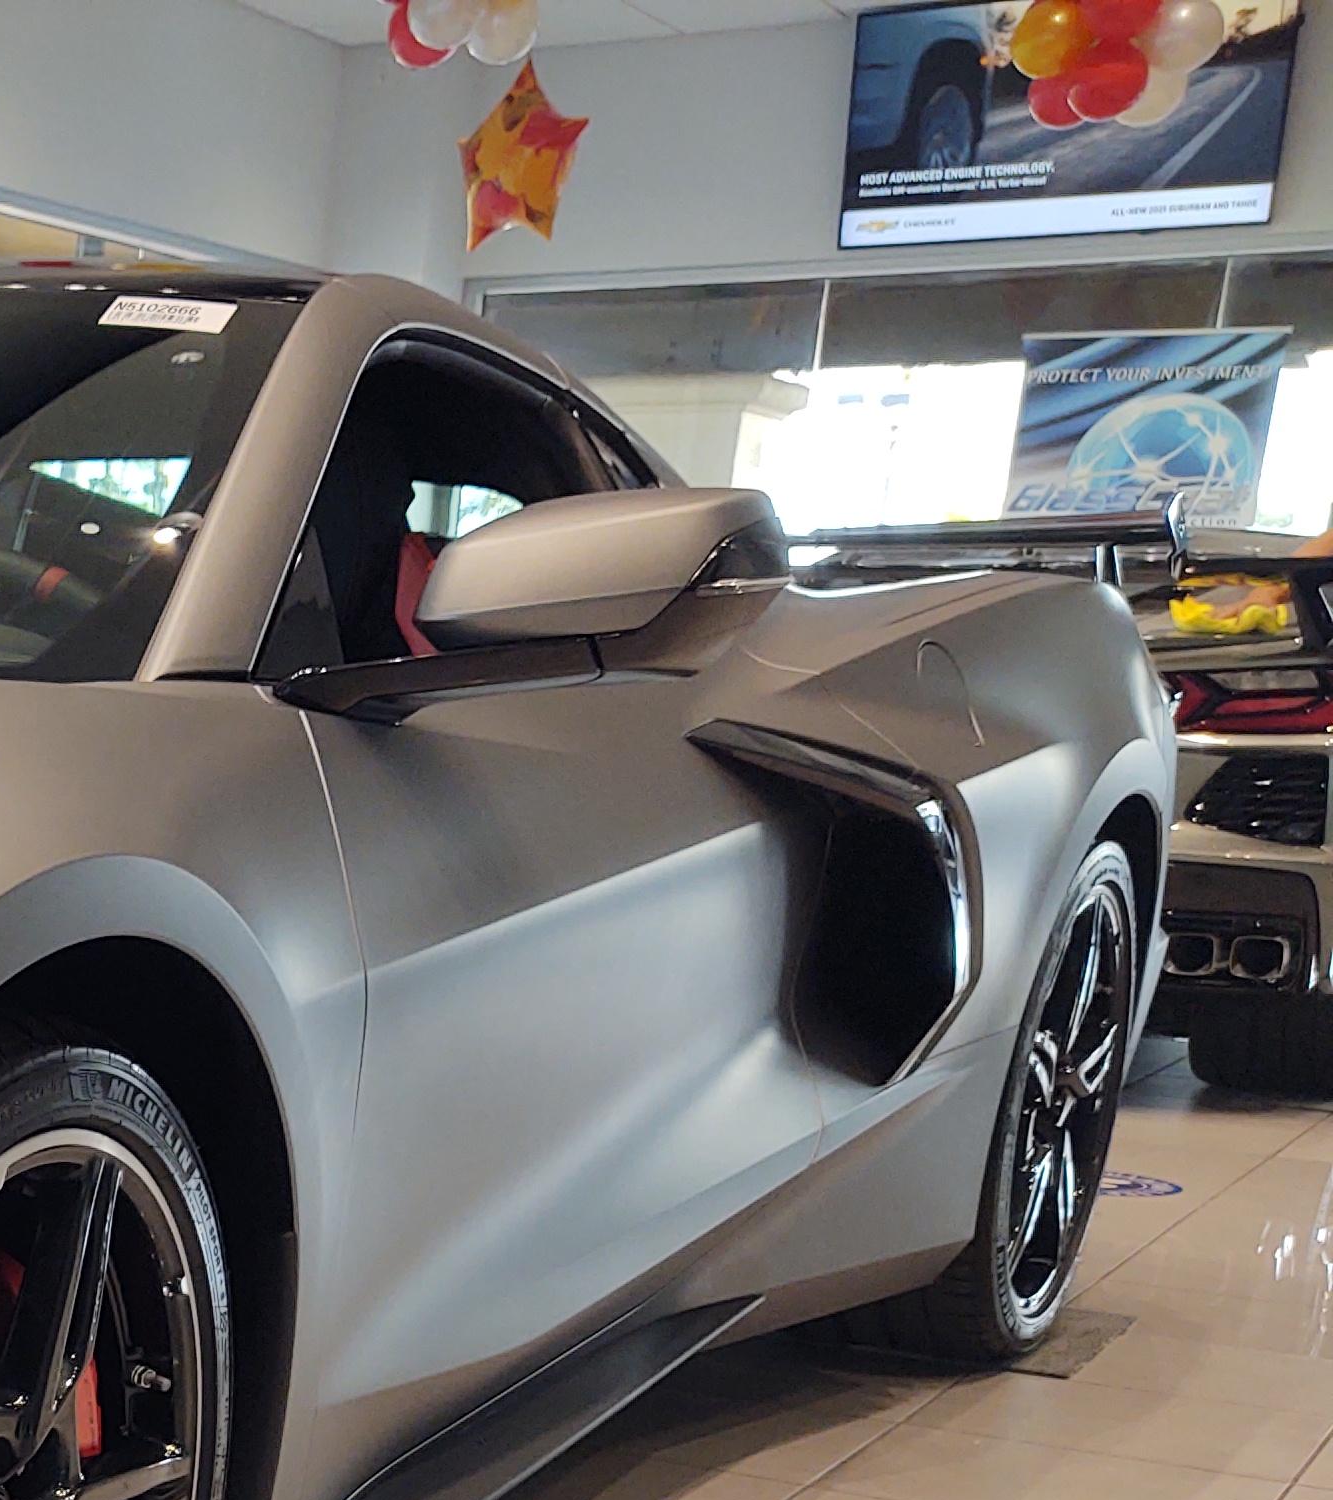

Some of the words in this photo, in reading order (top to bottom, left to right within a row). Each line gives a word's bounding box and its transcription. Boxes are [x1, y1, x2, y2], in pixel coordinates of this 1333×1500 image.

[860, 172, 888, 186] MOST
[888, 169, 943, 184] ADVANCED
[945, 166, 982, 180] ENGINE
[984, 162, 1055, 178] TECHNOLOGY.
[1112, 207, 1147, 217] ALL-NEW
[1169, 202, 1211, 213] SUBURBAN
[1213, 200, 1229, 209] AND
[1232, 199, 1258, 208] TAHOE
[114, 302, 202, 316] N5102666
[1026, 368, 1103, 384] PROTECT
[1106, 367, 1152, 381] YOUR
[108, 1078, 194, 1173] MICHELIN
[195, 1183, 213, 1222] PILOT
[209, 1225, 223, 1275] SPORT
